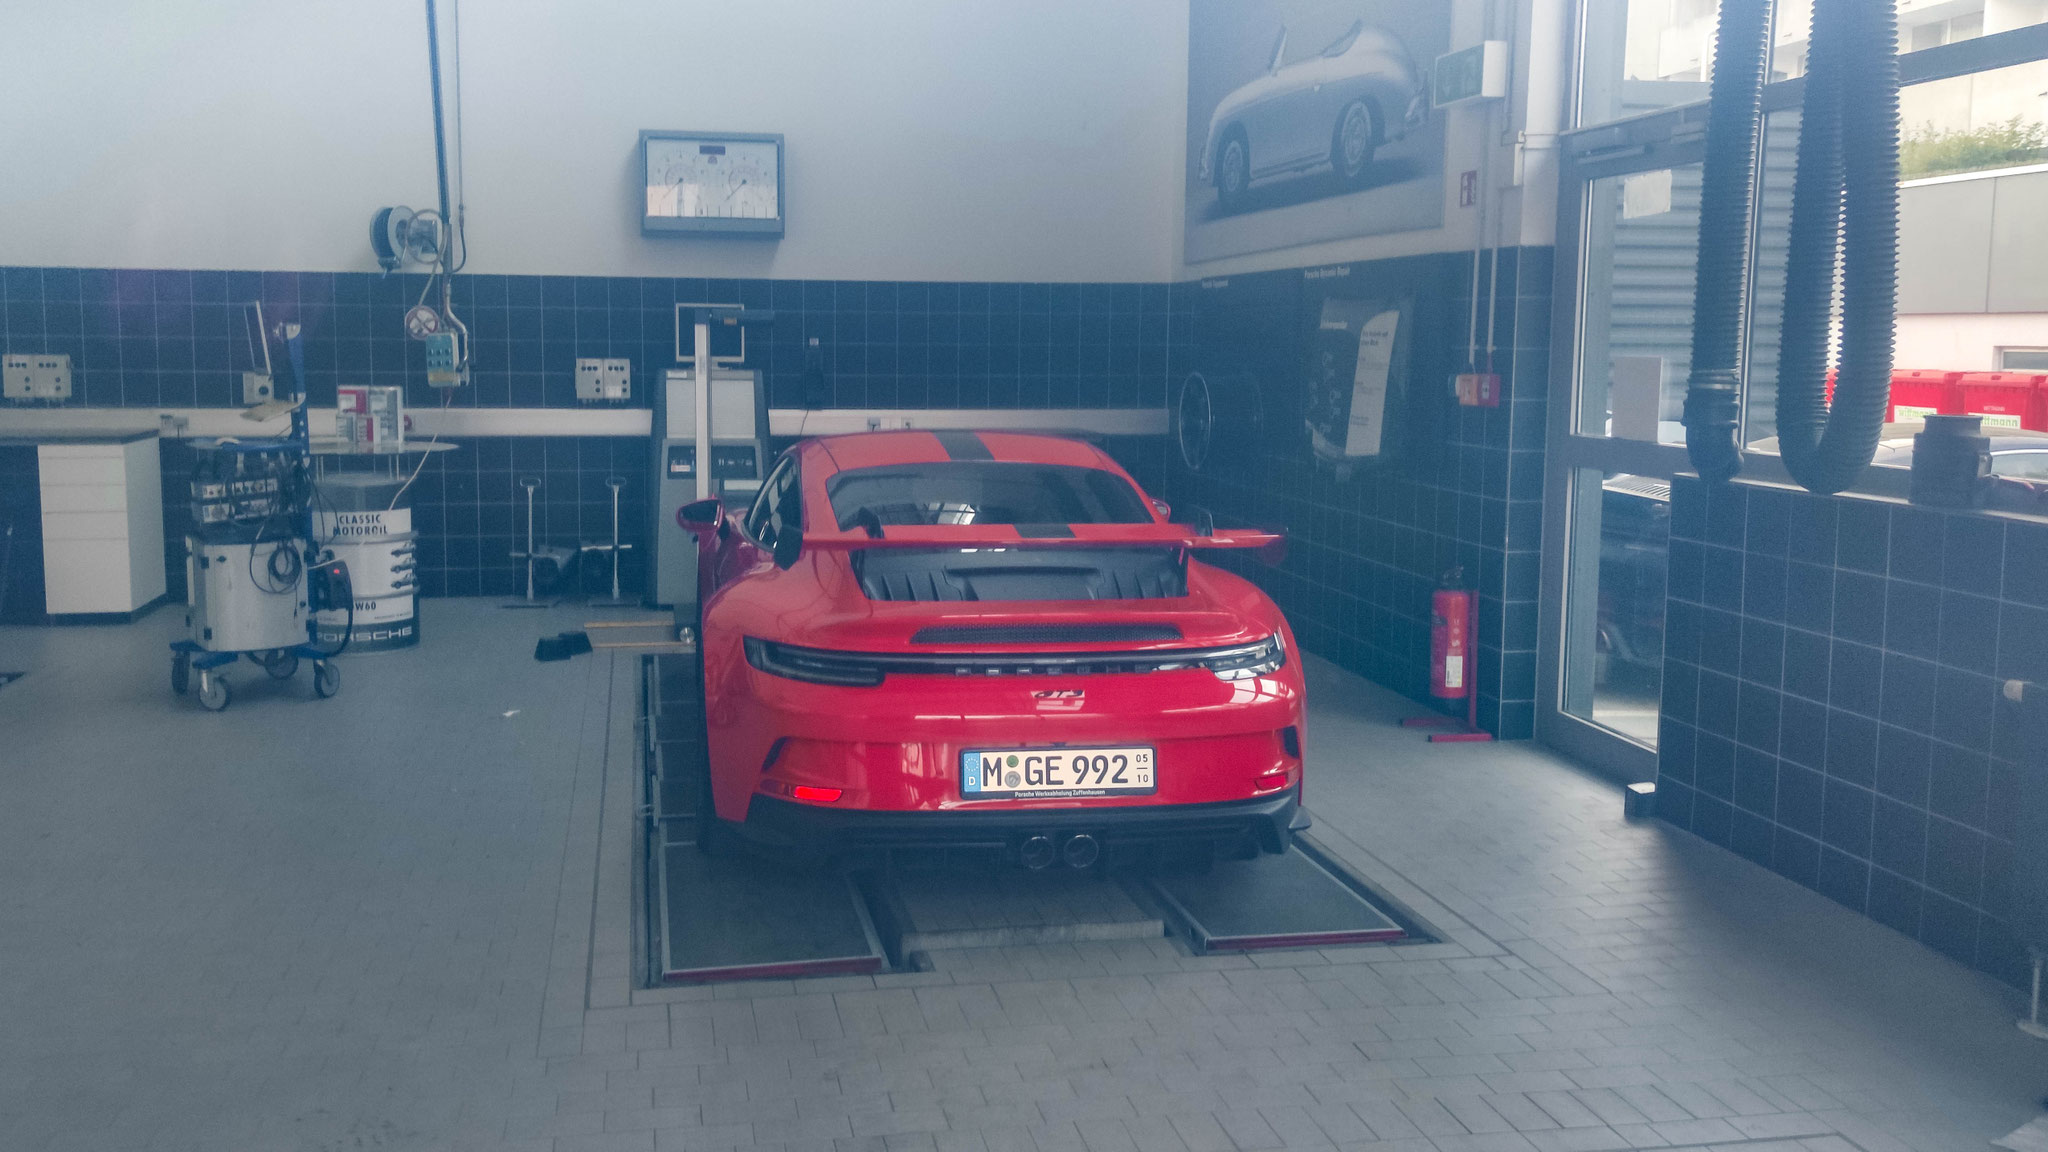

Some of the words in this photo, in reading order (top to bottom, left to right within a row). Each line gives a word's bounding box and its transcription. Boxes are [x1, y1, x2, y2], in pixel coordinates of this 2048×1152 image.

[339, 514, 381, 524] CLASSIC
[333, 525, 388, 536] MOTOROIL
[1034, 689, 1084, 698] GT3
[1135, 753, 1149, 763] 05
[982, 757, 1002, 787] M
[1024, 755, 1065, 786] GE
[1072, 754, 1129, 784] 992
[968, 776, 976, 786] D
[1136, 774, 1149, 783] 10
